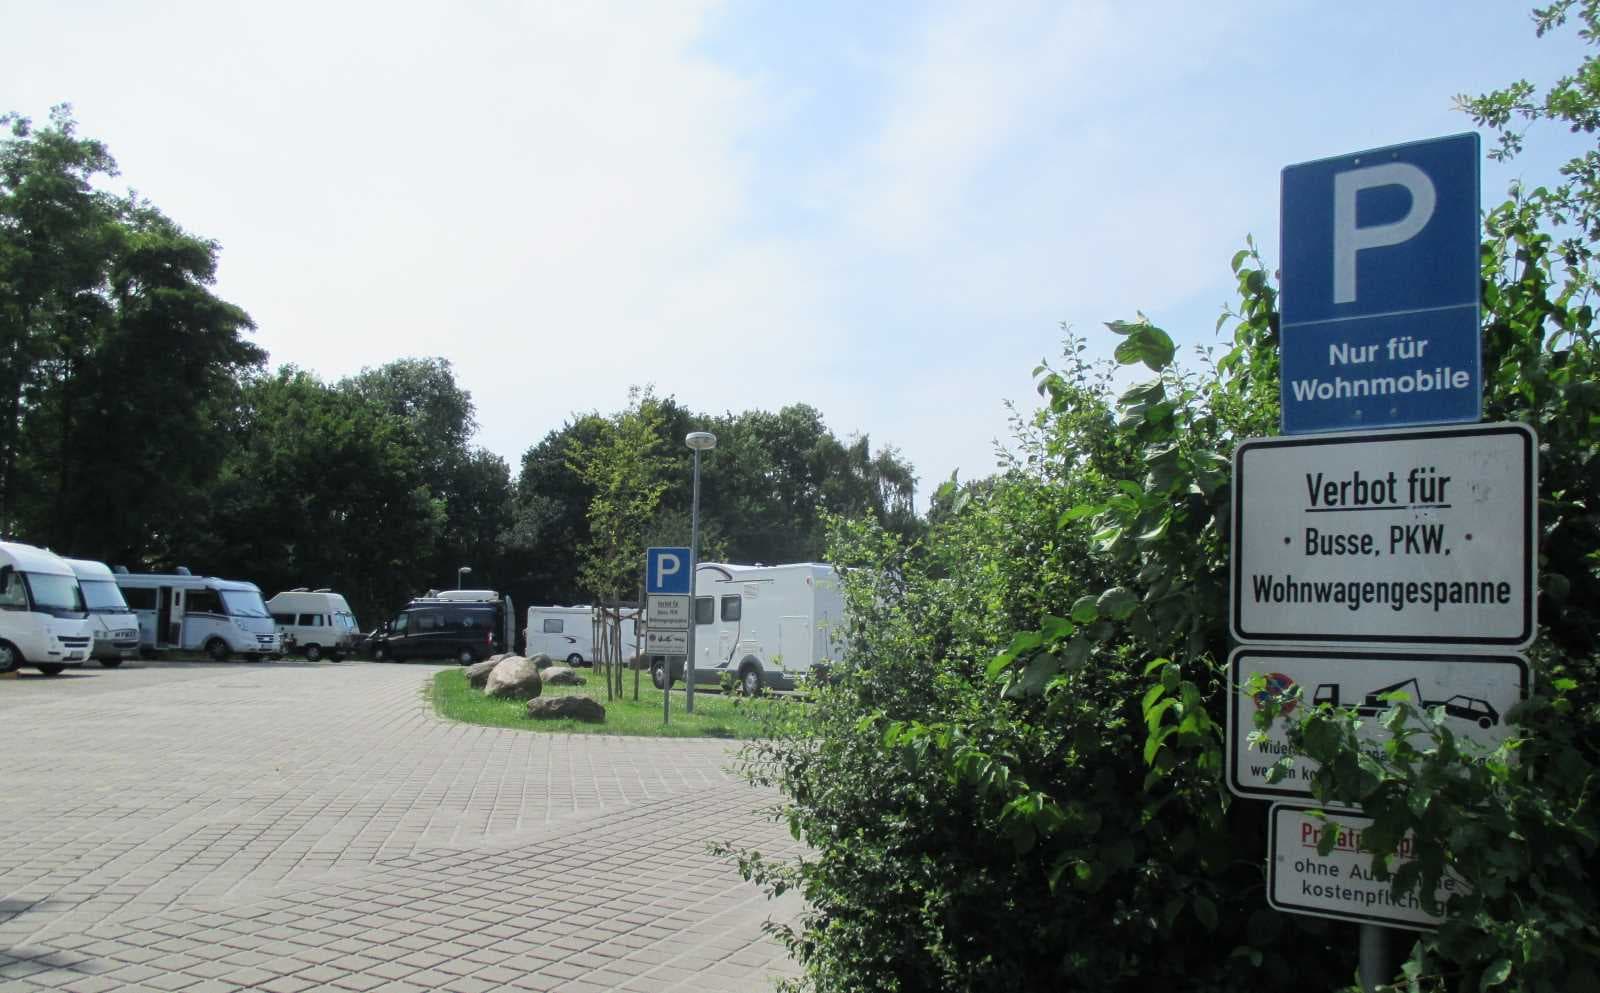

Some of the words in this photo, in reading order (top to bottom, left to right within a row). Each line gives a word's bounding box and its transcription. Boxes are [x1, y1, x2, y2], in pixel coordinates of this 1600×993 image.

[1333, 162, 1436, 304] P
[1329, 342, 1379, 365] Nur
[1387, 337, 1428, 358] für
[1292, 368, 1470, 401] Wohnmobile
[1306, 471, 1397, 506] Verbot
[1408, 466, 1451, 503] für
[1305, 527, 1380, 557] Busse,
[1389, 524, 1452, 555] PKW,
[656, 554, 681, 588] P
[1252, 574, 1510, 611] Wohnwagengespanne
[1294, 858, 1340, 877] ohne
